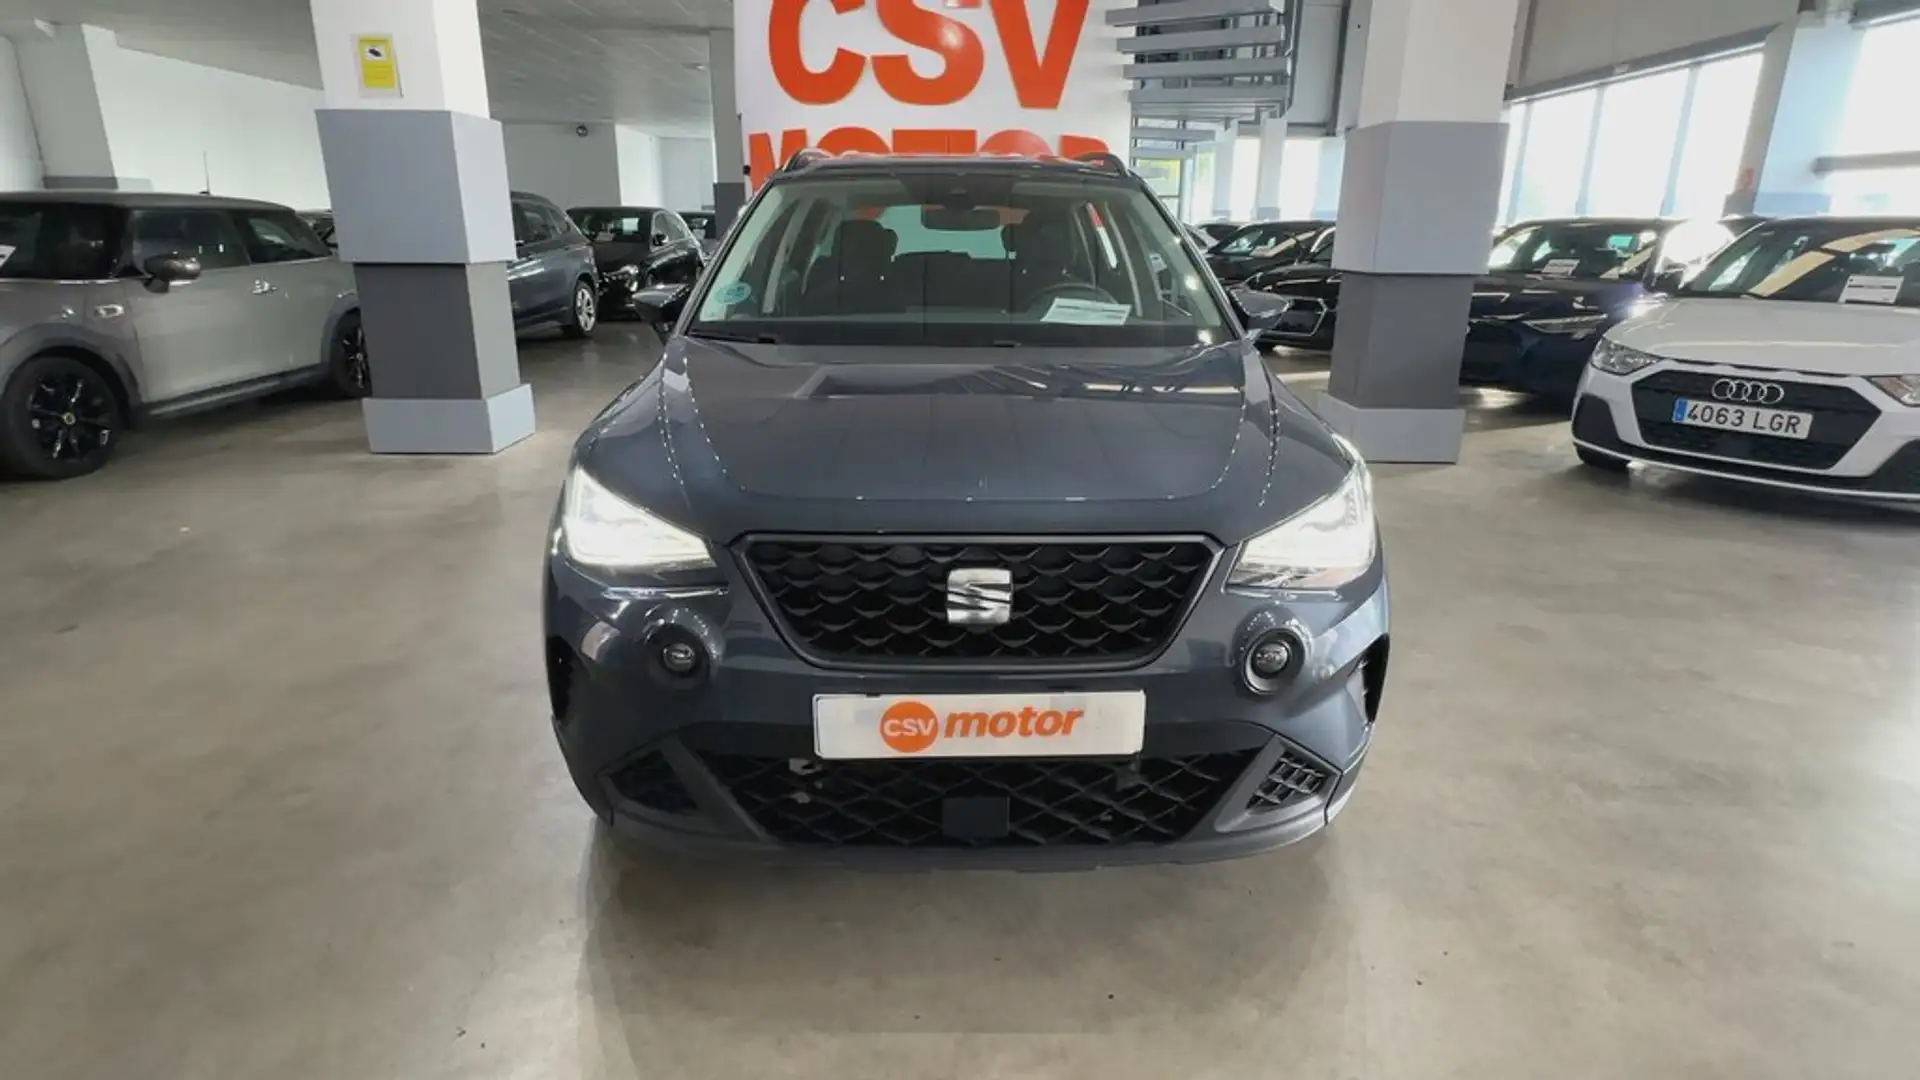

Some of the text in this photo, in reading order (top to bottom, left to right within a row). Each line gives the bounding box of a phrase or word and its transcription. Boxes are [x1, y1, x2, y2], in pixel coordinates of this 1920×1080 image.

[768, 0, 1090, 109] CSV
[1687, 404, 1801, 434] 4063 LGR
[884, 706, 1084, 738] CSV motor
